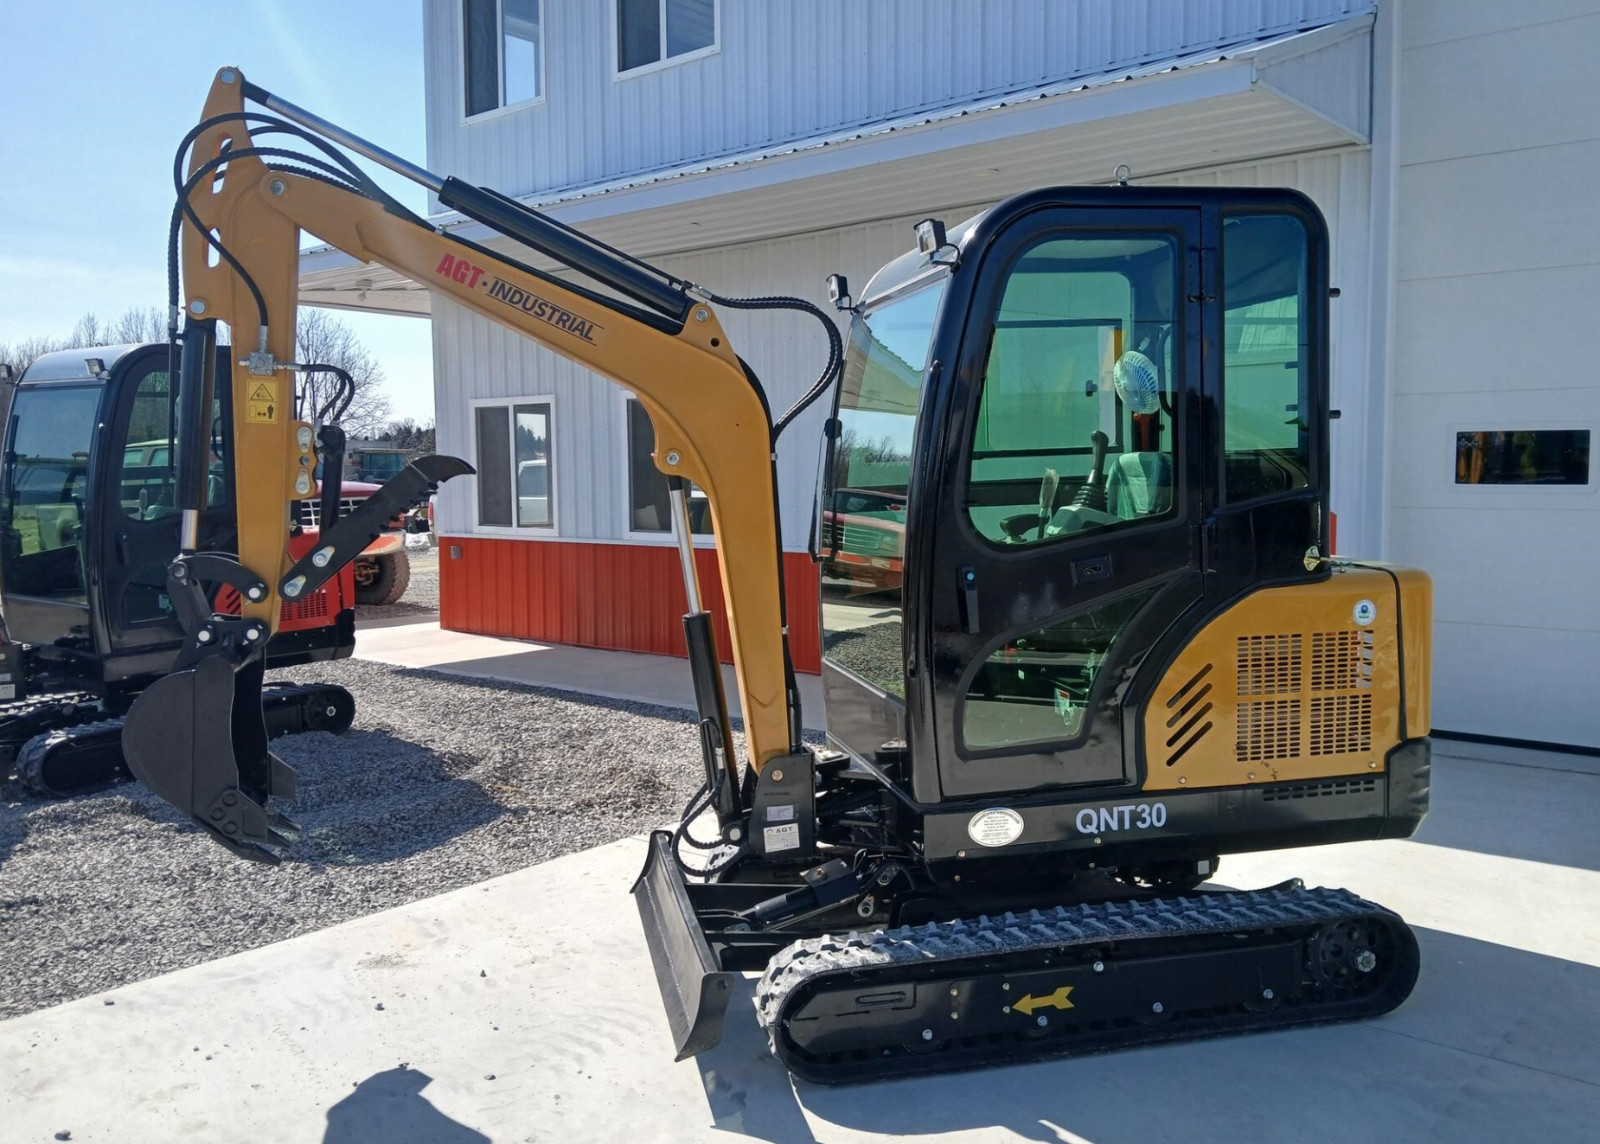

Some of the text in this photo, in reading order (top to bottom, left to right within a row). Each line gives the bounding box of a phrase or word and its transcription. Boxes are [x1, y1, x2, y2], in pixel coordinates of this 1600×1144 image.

[435, 253, 593, 342] AGT INDUSTRIAL
[776, 826, 793, 834] AGT
[1075, 802, 1167, 834] QNT30
